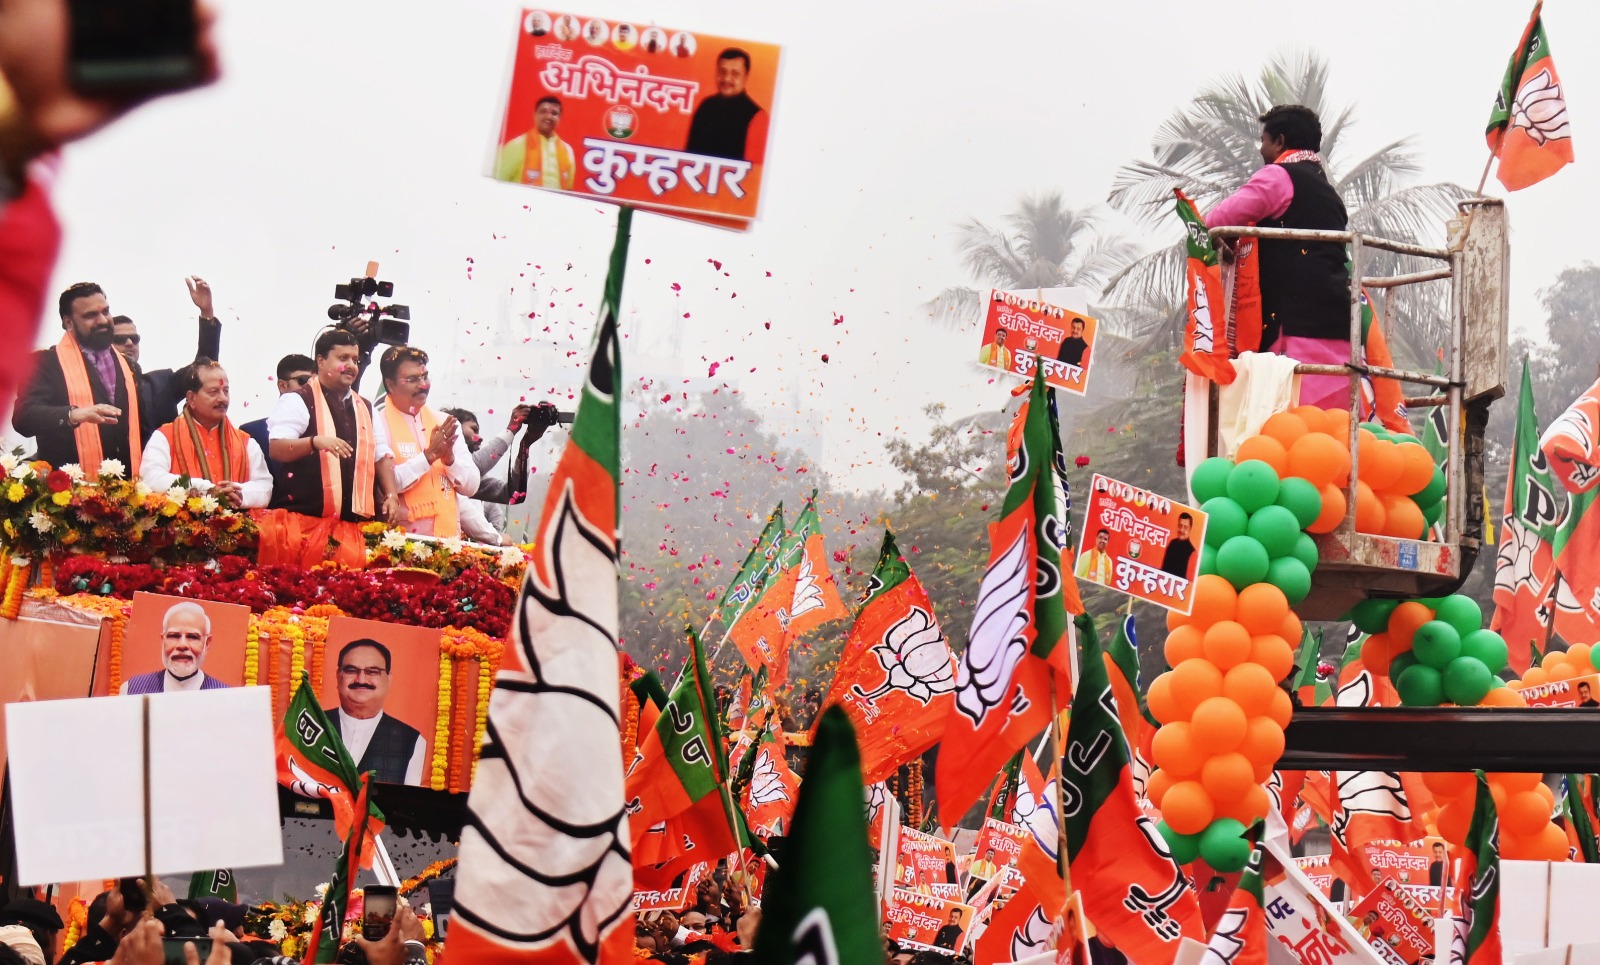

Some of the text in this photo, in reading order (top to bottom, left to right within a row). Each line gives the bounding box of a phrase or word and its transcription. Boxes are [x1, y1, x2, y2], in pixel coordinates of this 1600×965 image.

[539, 54, 699, 114] अभिनंदन
[583, 137, 751, 199] कुम्हरार
[998, 312, 1064, 343] अभिनंदन
[1014, 348, 1083, 383] कुहरार
[1100, 506, 1170, 548] अभिनंदन
[1115, 556, 1189, 601] कुम्हरार
[1369, 850, 1429, 870] अभिनंदन
[886, 906, 942, 931] अभिनंदन
[1377, 901, 1433, 955] अभिनंदन
